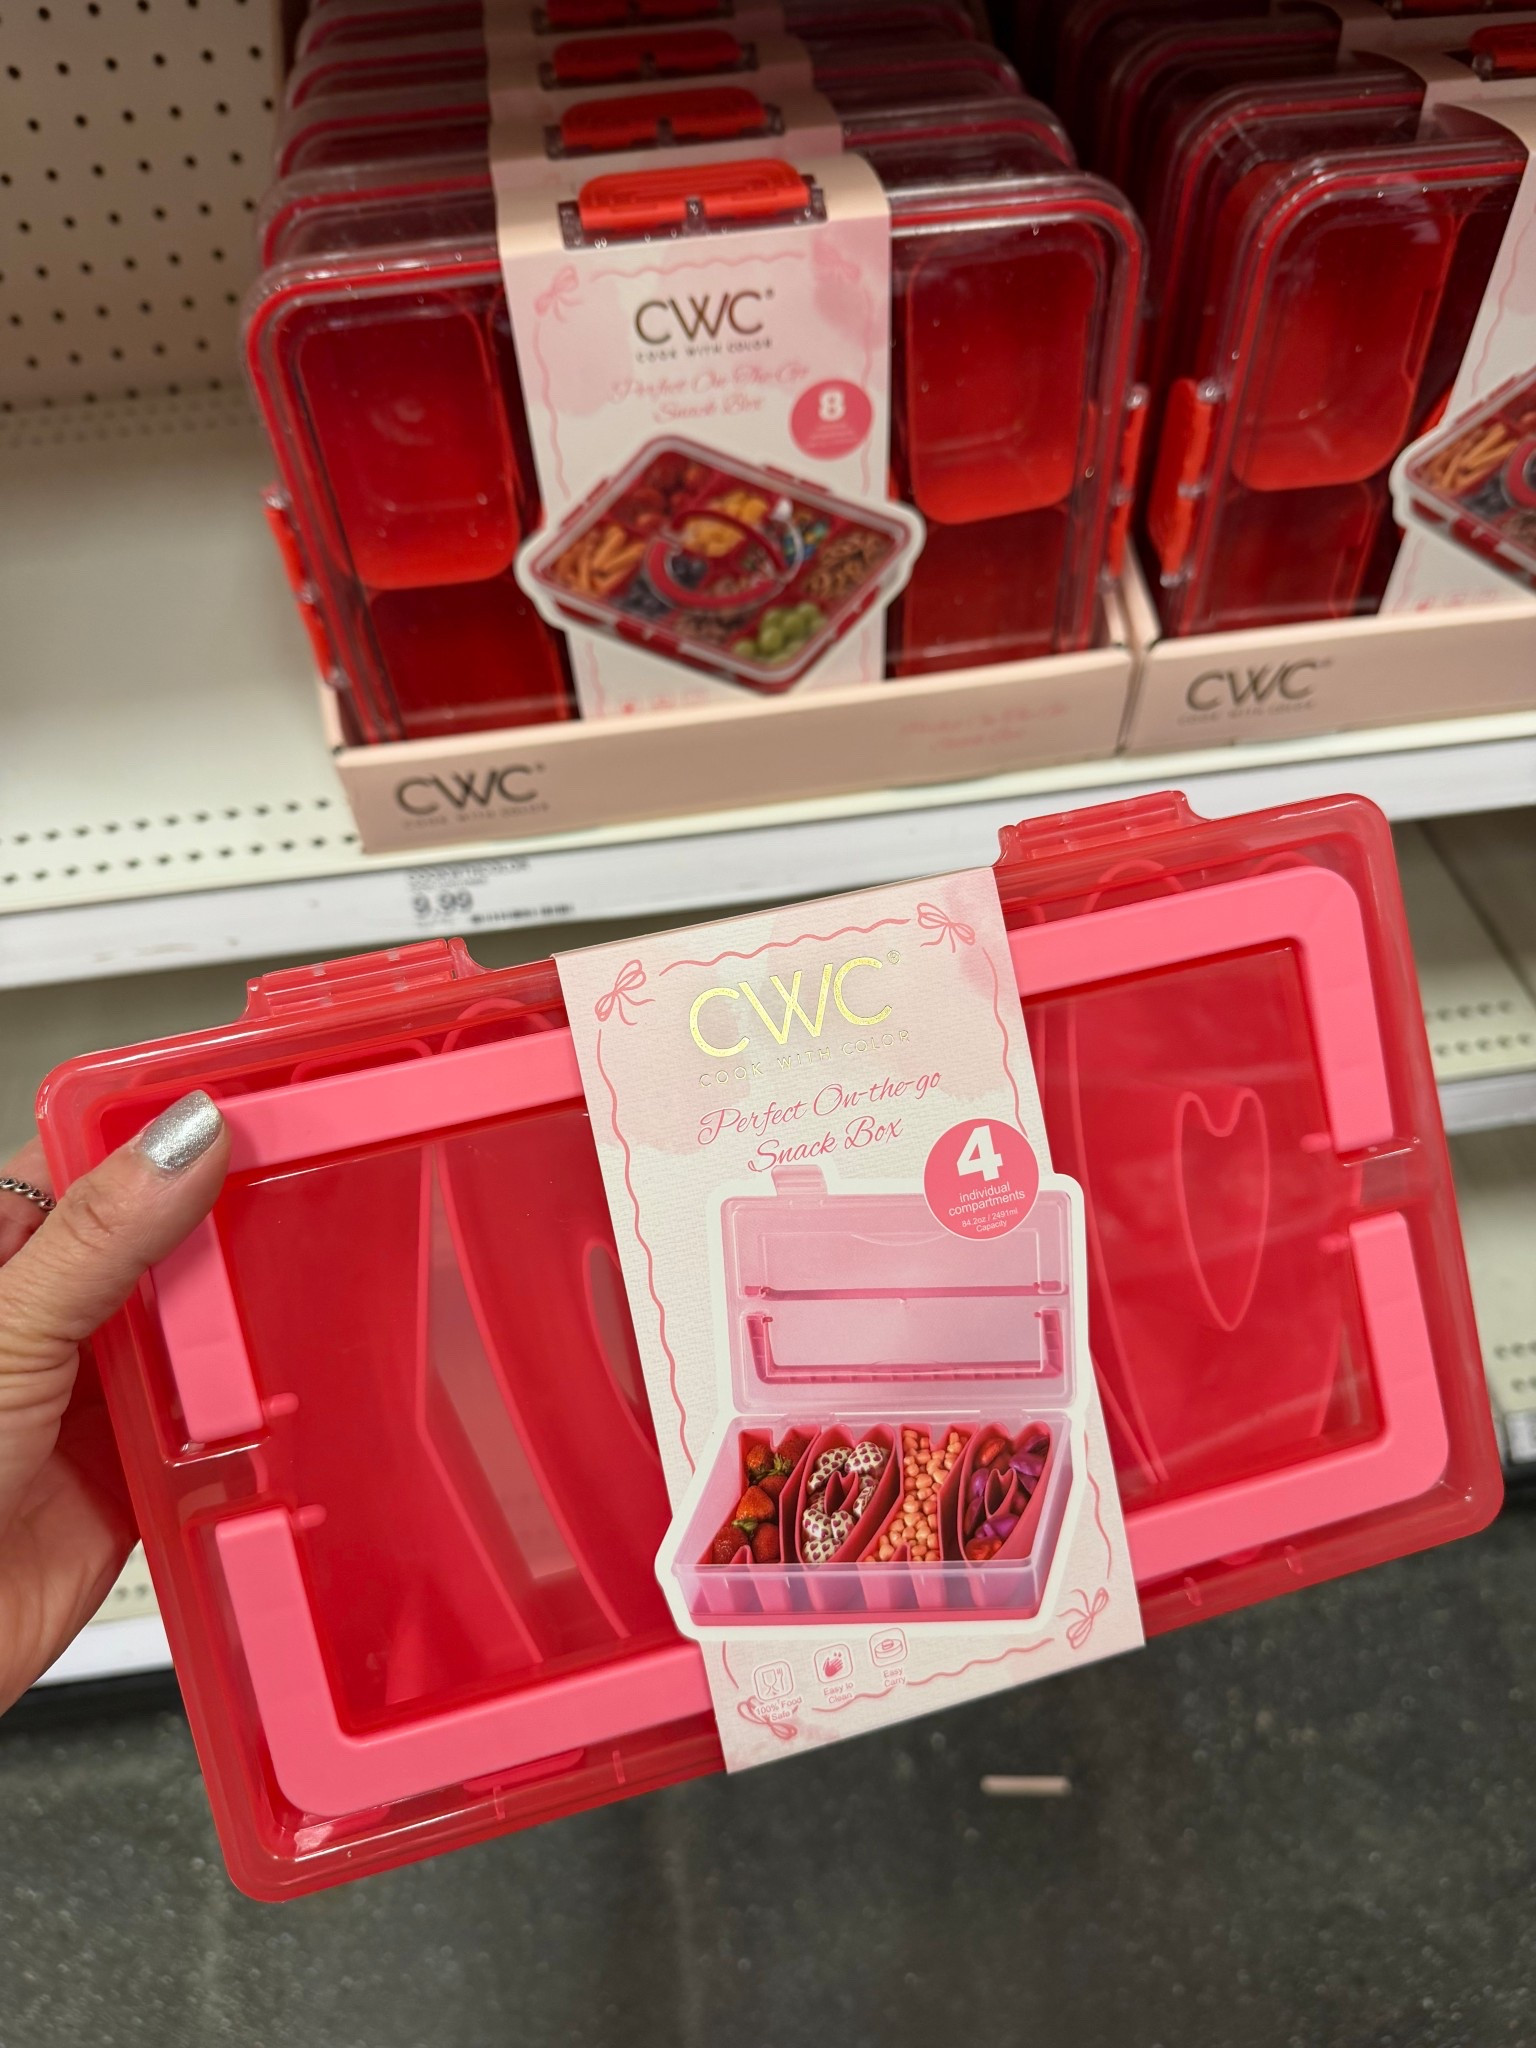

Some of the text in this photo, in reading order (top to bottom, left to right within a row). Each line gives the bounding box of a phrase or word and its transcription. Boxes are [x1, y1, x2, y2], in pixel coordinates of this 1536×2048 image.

[634, 290, 764, 346] CWC
[818, 388, 846, 422] 8
[1186, 658, 1314, 711] CWC
[395, 763, 538, 815] CWC
[412, 888, 473, 915] 9.99
[689, 956, 894, 1058] CWC
[698, 1029, 912, 1088] COOK WITH COLOR
[697, 1071, 943, 1147] Perfect On-the-go
[747, 1117, 904, 1174] Snack Box
[956, 1125, 1003, 1182] 4
[948, 1190, 1026, 1217] compartments
[959, 1181, 1011, 1203] individual
[961, 1215, 986, 1228] 84.2oz
[992, 1207, 1018, 1220] 2491ml
[976, 1220, 1007, 1233] Capacity
[882, 1667, 904, 1679] Easy
[884, 1675, 907, 1688] Carry
[823, 1685, 844, 1698] Easy
[828, 1691, 854, 1705] Clean
[755, 1696, 803, 1717] 100% Food
[770, 1711, 792, 1722] Safe
